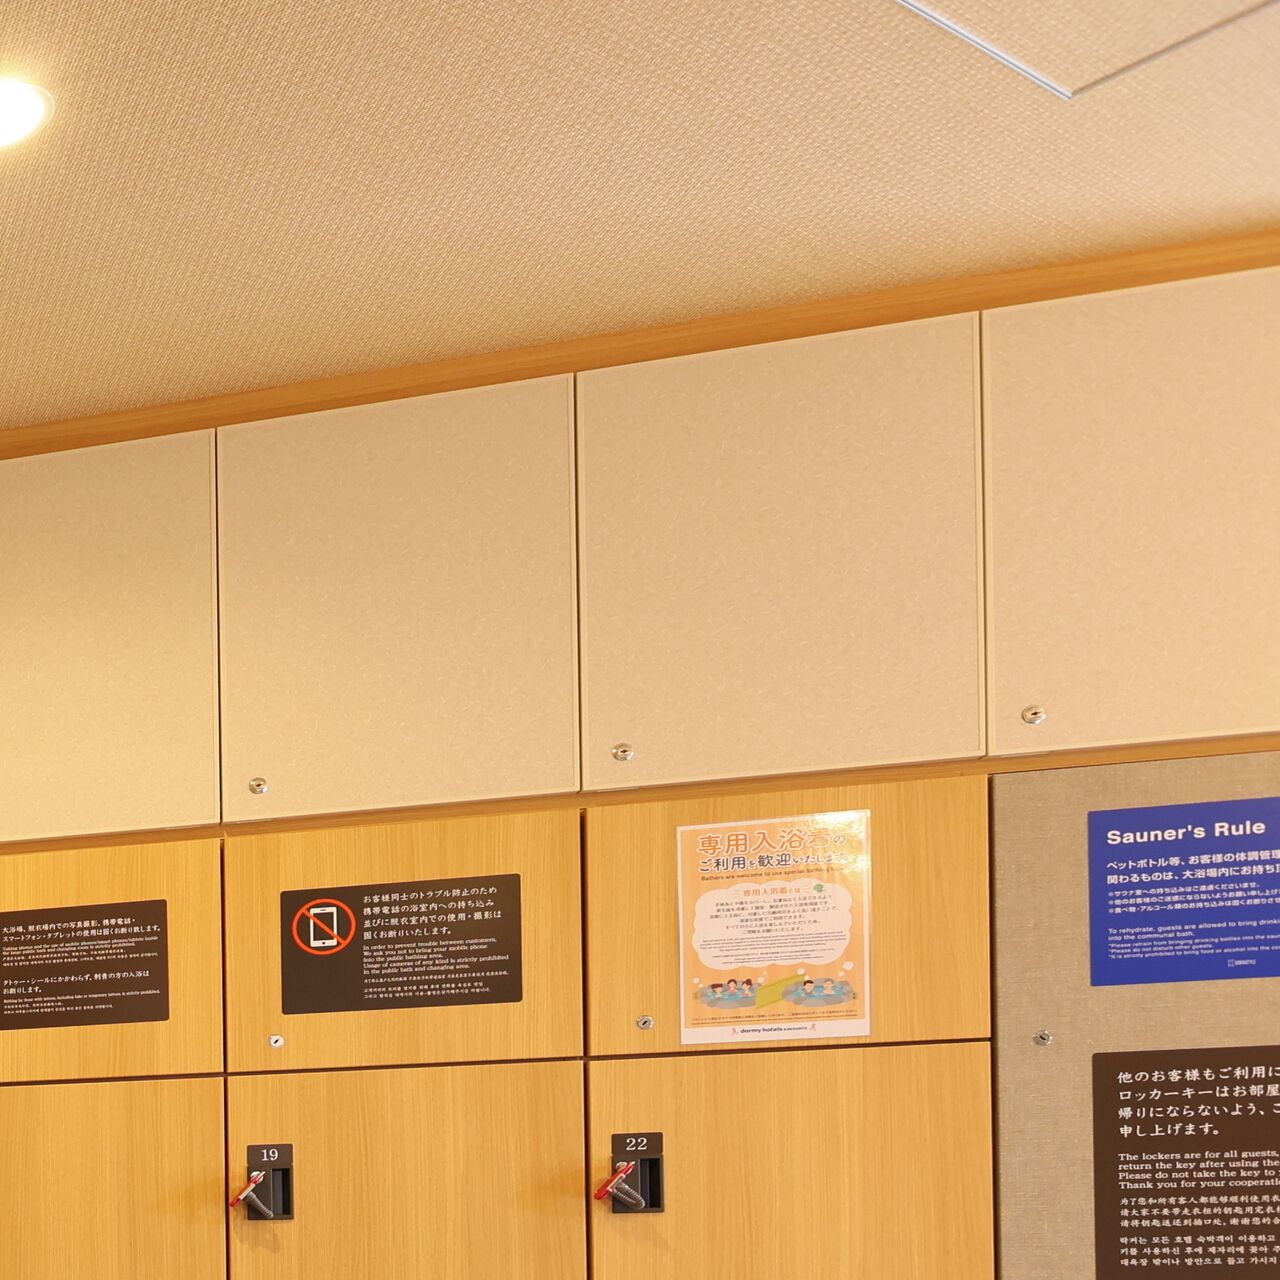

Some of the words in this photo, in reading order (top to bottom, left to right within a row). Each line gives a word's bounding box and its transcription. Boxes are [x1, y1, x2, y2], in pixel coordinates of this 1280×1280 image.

[1107, 825, 1206, 844] Sauner's
[1214, 821, 1266, 836] Rule
[363, 886, 497, 903] お客様同士のトラブル防止のため
[363, 899, 494, 915] 携帯電話の浴室内への持ち込み
[363, 910, 502, 928] 並びに脱衣室内での使用・撮影は
[363, 927, 451, 940] 固くお断りいたします。
[1119, 1123, 1219, 1138] 申し上げます。
[626, 1138, 646, 1150] 22
[262, 1148, 278, 1160] 19
